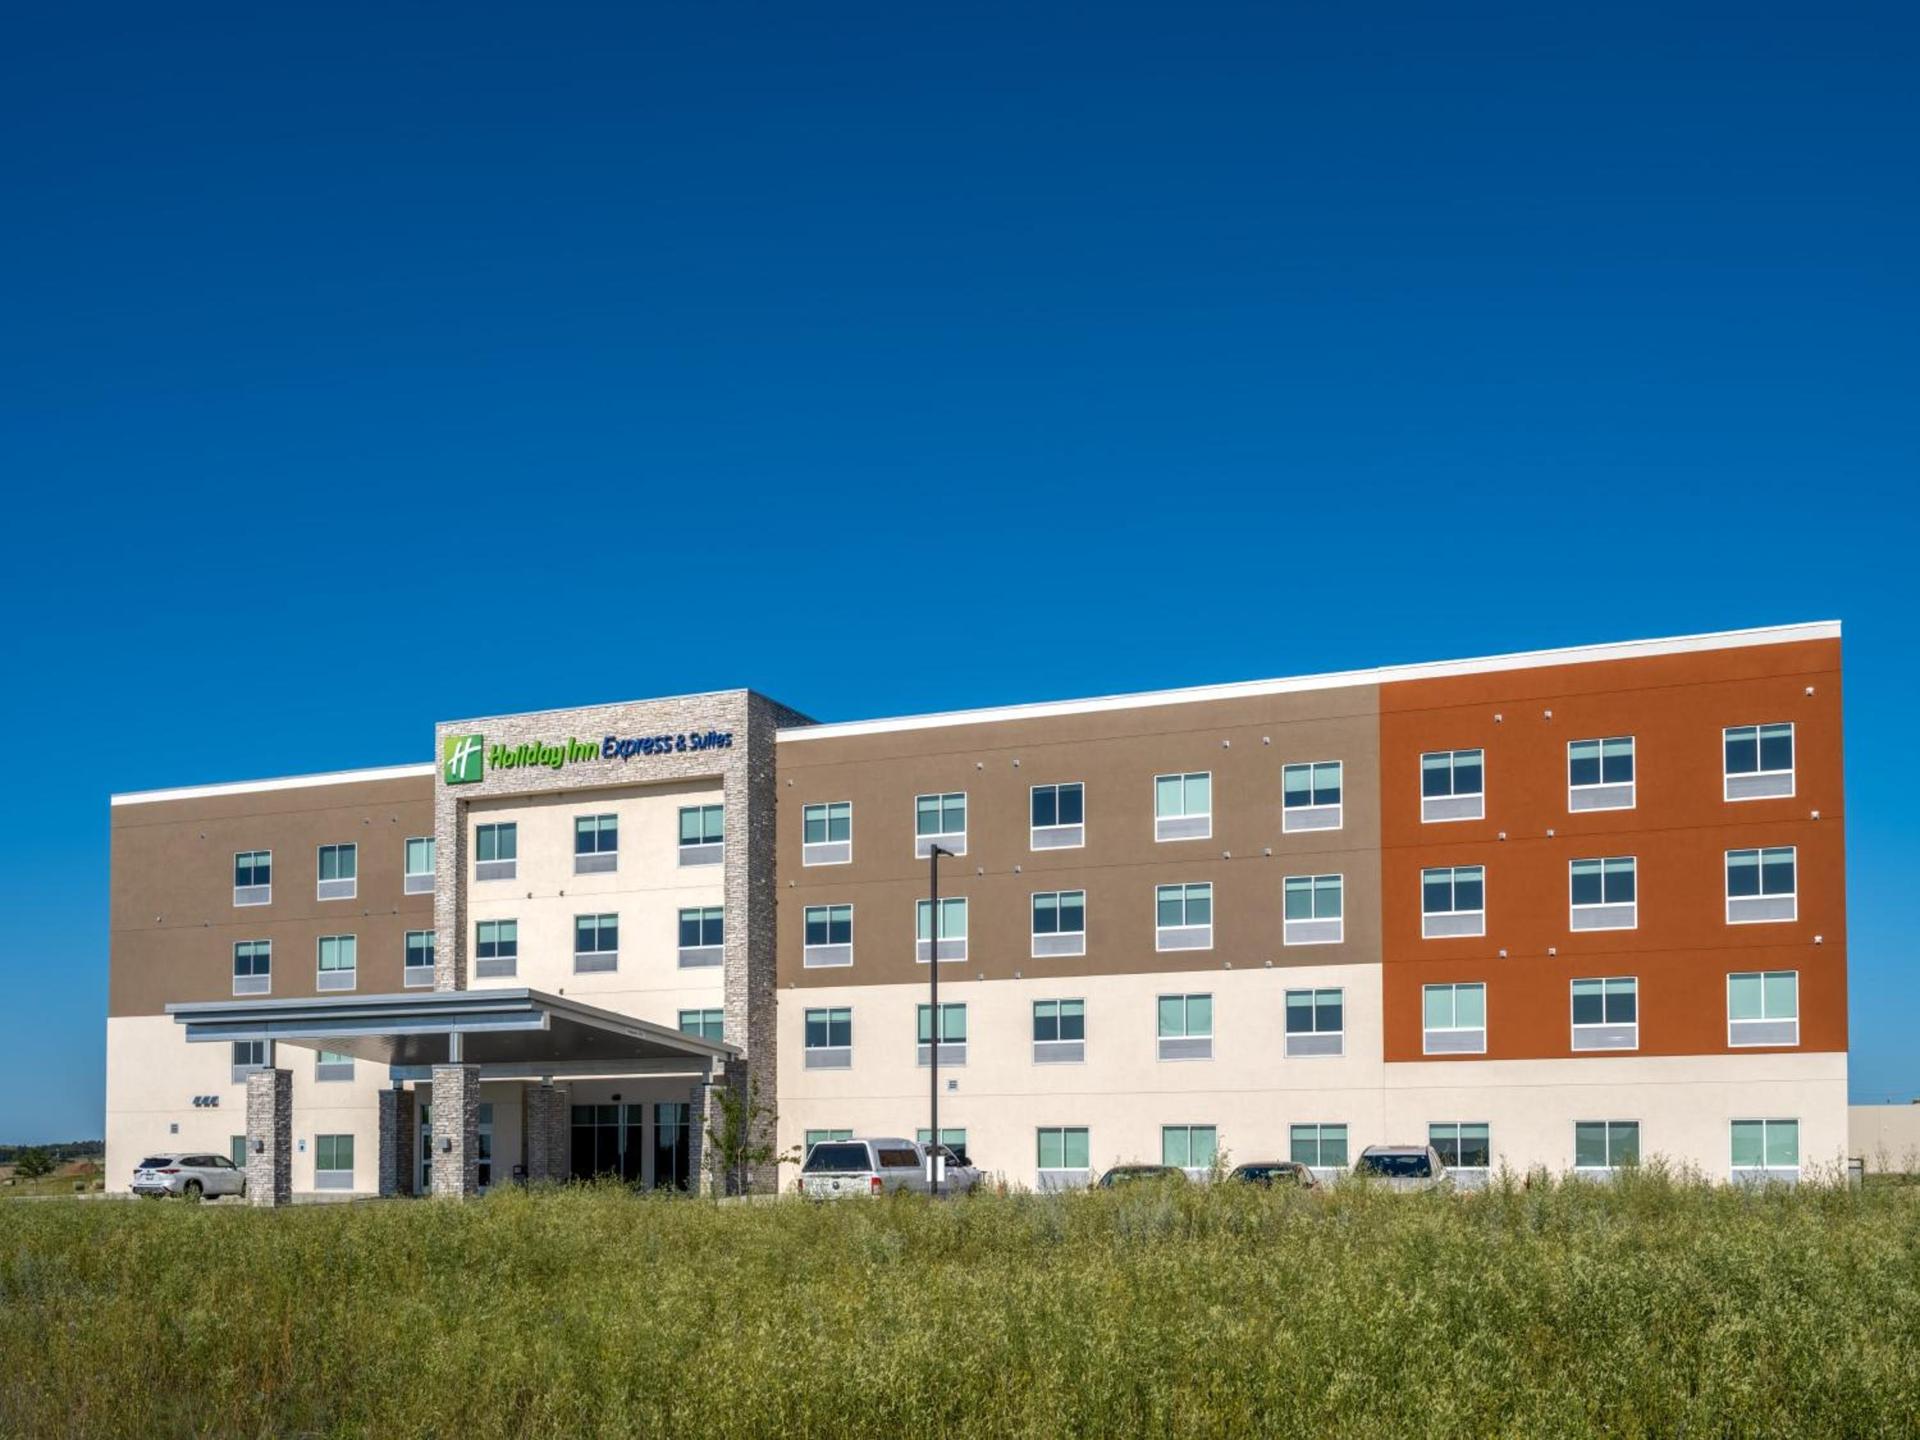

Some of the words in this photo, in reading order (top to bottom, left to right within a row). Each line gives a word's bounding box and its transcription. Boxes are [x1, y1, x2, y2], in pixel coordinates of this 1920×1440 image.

[489, 740, 565, 770] Holiday
[568, 736, 600, 763] Inn
[601, 735, 673, 762] Express
[676, 734, 687, 752] &
[690, 730, 733, 751] Suites
